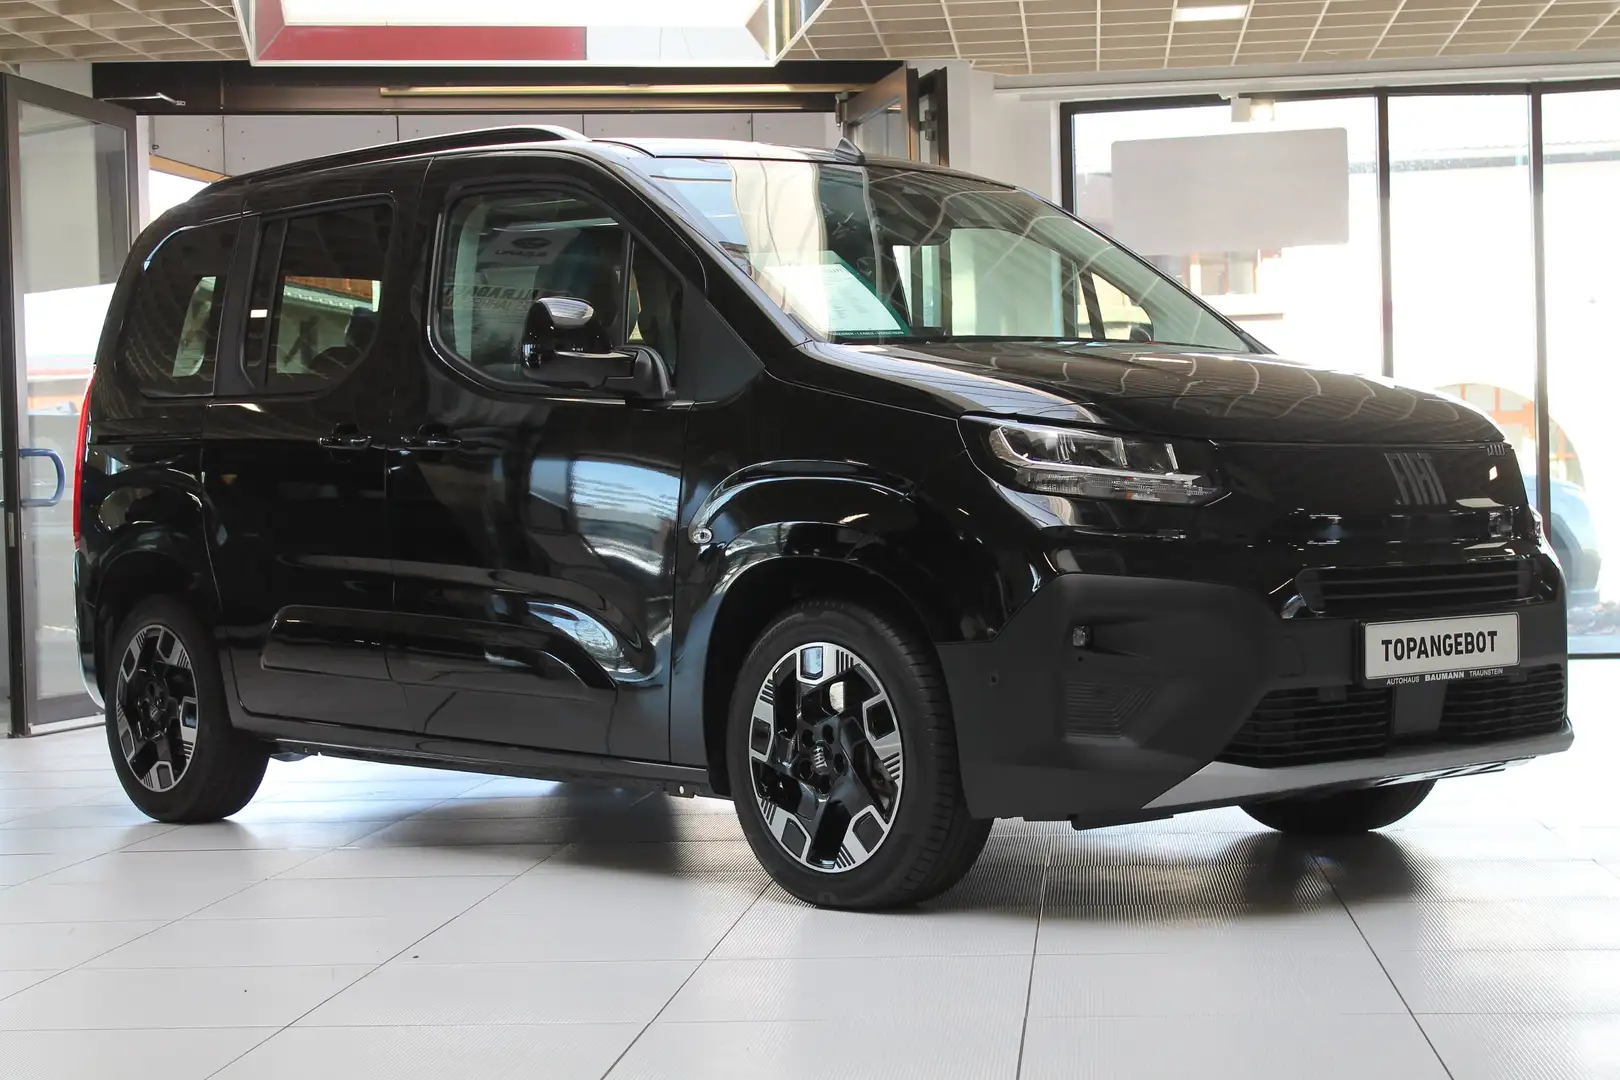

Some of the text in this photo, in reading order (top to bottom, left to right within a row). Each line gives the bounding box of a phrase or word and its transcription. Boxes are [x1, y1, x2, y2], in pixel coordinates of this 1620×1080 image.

[1383, 452, 1447, 505] FIAT
[1381, 630, 1498, 662] TOPANGEBOT
[1386, 668, 1504, 686] AUTOHAUS BAUMANN TRAUNSTEIN
